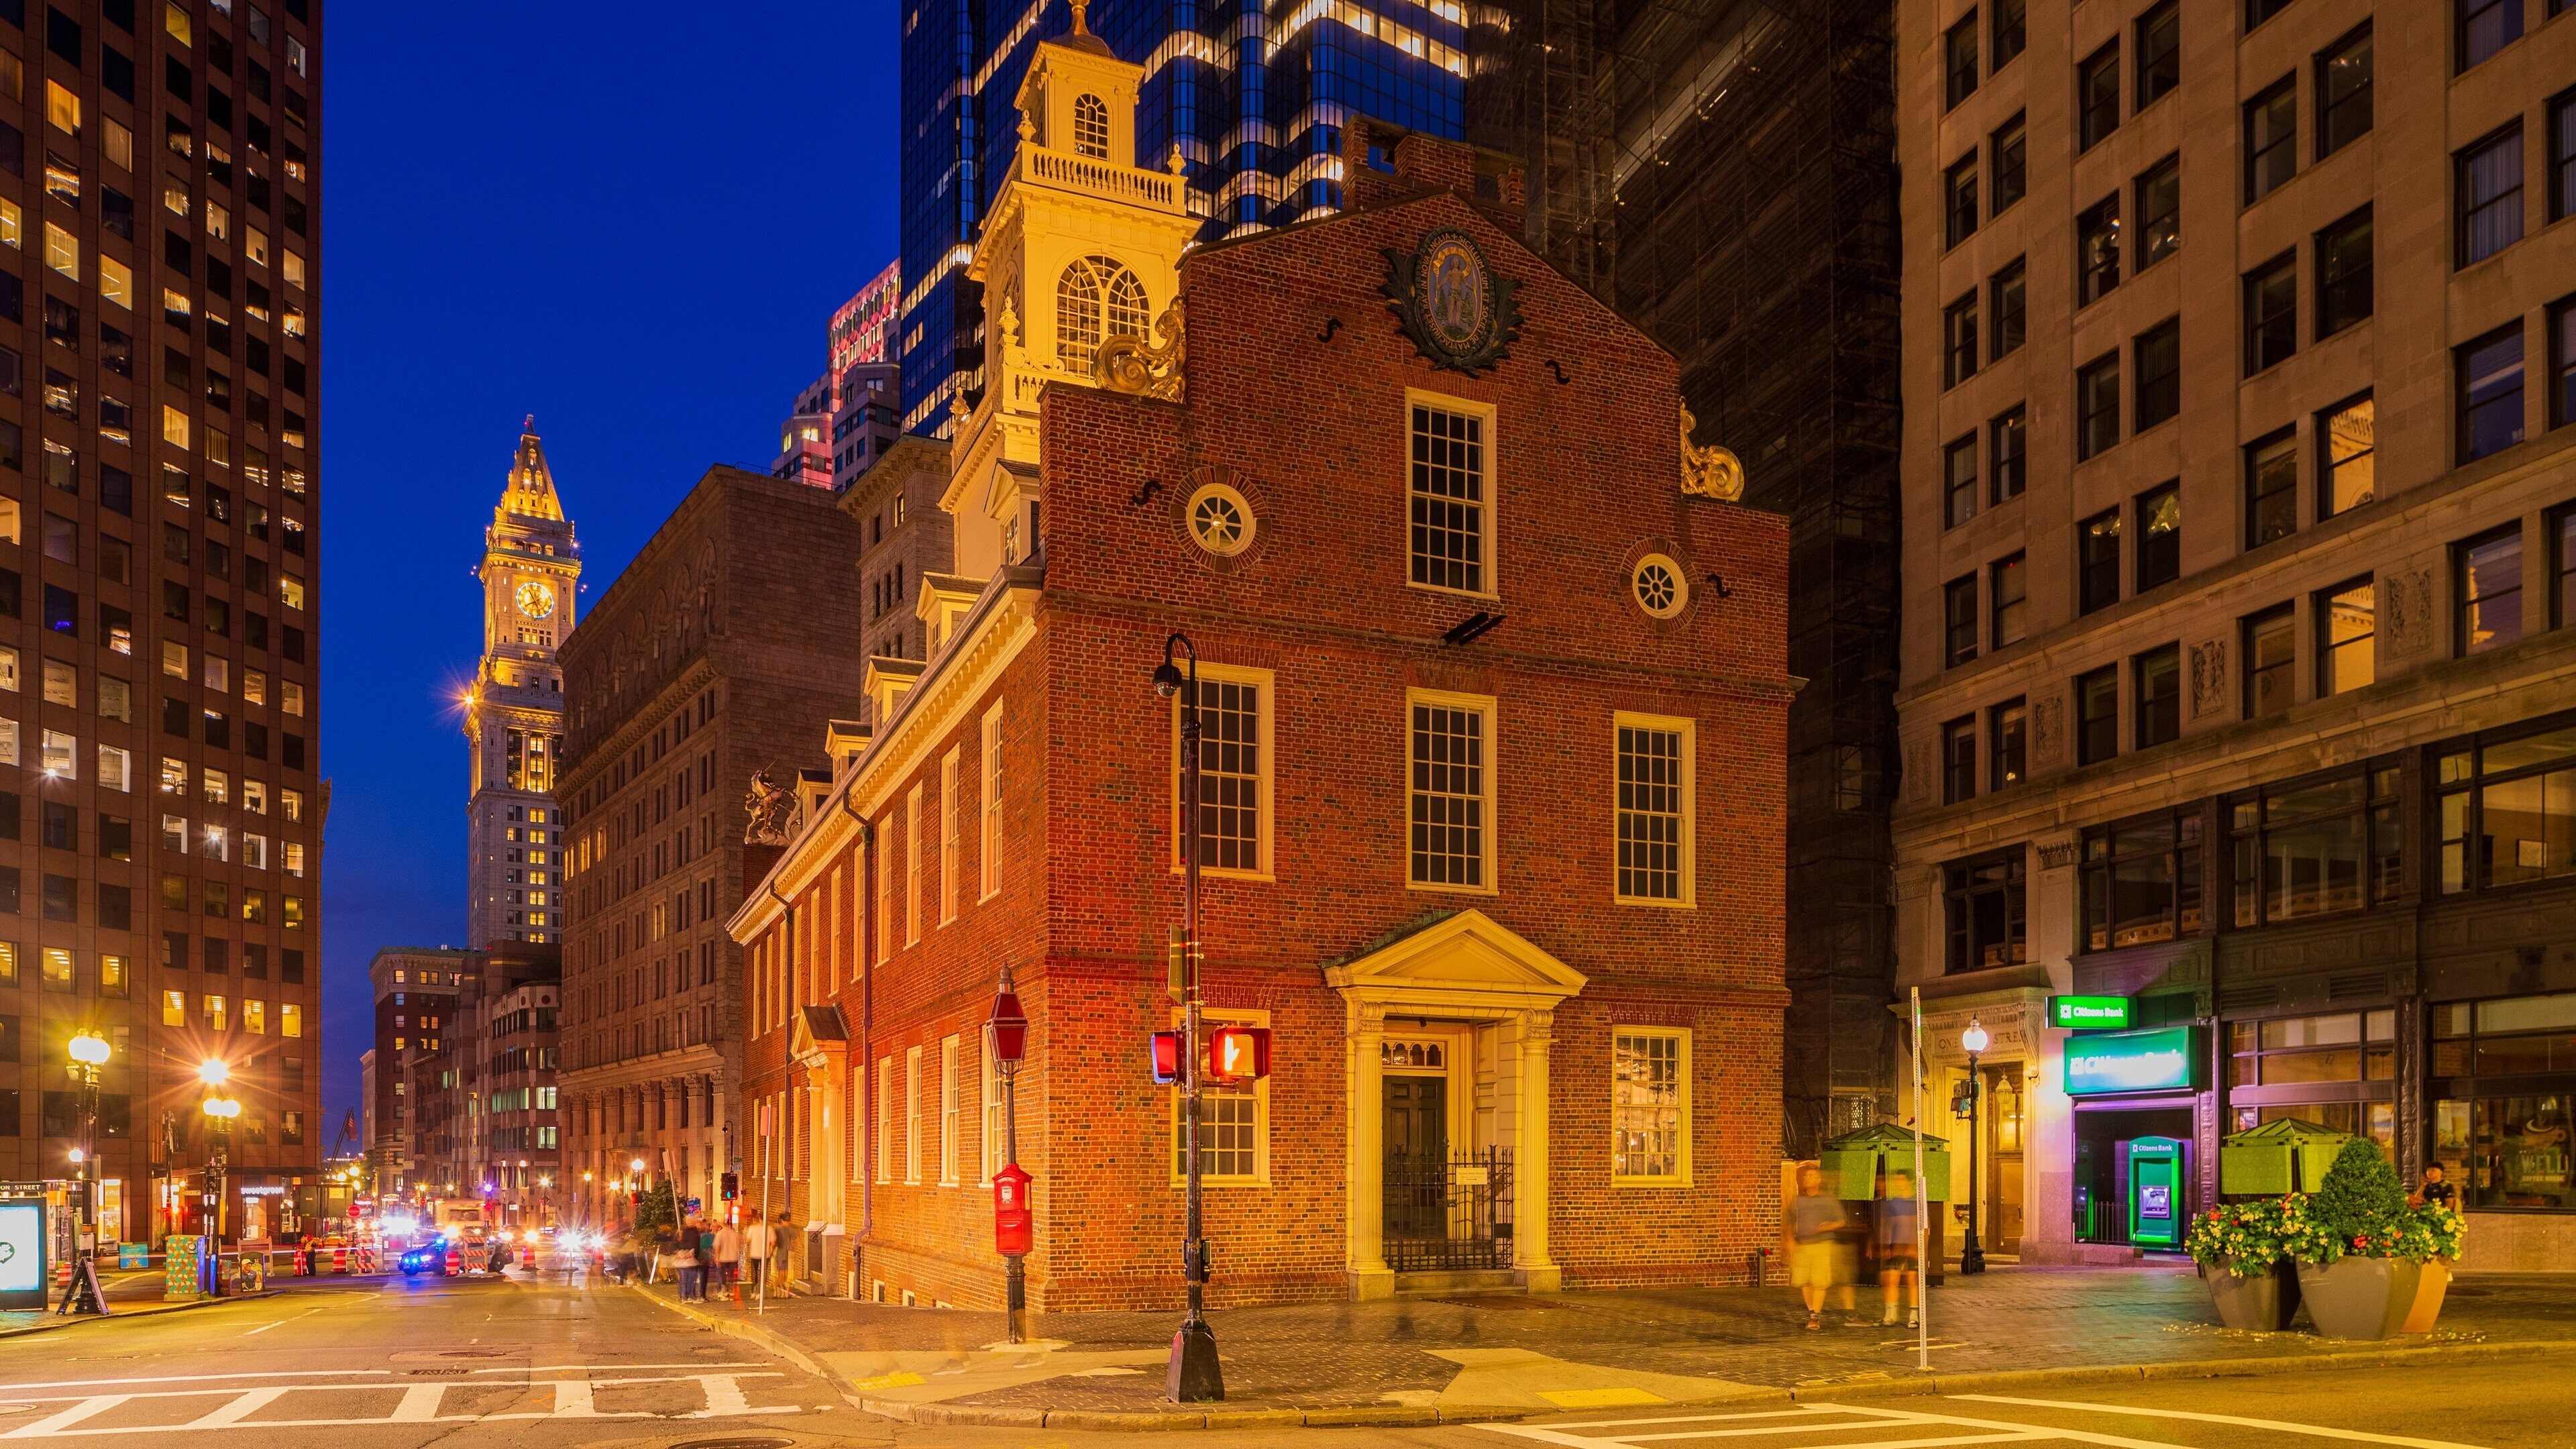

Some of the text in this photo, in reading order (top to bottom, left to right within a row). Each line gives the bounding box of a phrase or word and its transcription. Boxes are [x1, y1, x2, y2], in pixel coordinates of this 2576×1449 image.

[1421, 256, 1430, 278] NOVA
[1421, 280, 1428, 289] IN
[1481, 271, 1489, 289] CUM
[1420, 292, 1429, 309] BAY
[1482, 294, 1489, 303] ET
[1471, 335, 1480, 345] DE
[2074, 1006, 2124, 1017] Citizens Bank
[1939, 1038, 1958, 1049] ONE
[241, 1187, 284, 1195] sweetgreen
